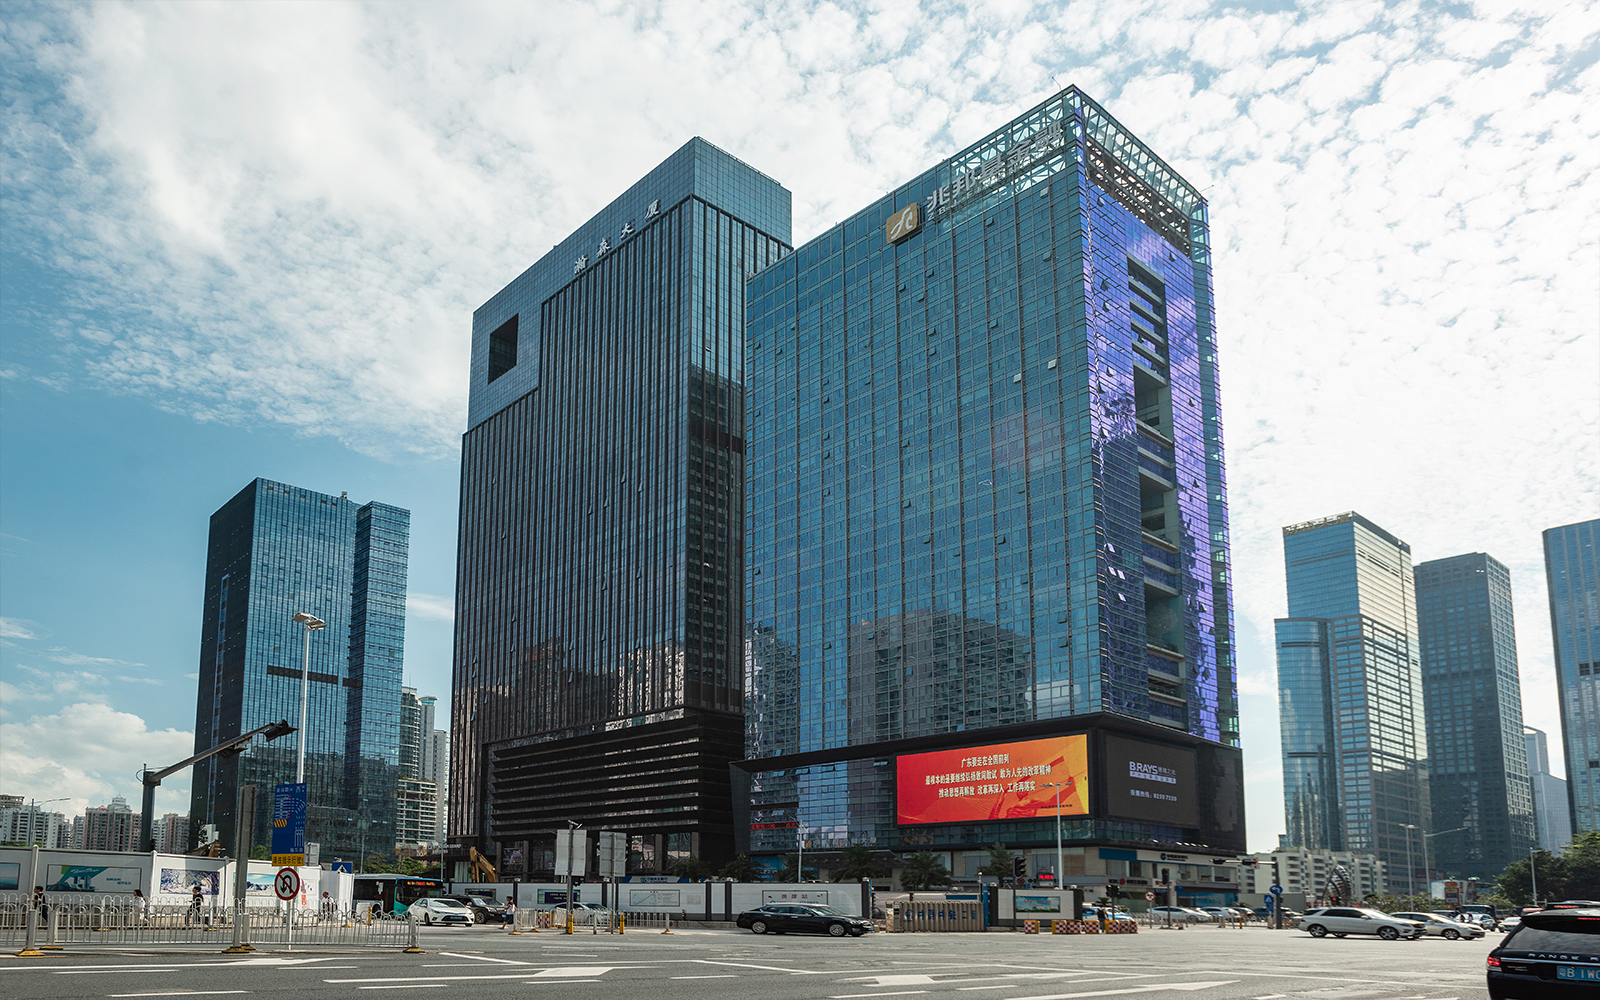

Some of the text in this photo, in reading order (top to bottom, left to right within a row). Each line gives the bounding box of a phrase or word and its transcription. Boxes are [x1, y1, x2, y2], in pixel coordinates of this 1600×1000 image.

[961, 753, 1010, 768] 广东要走在全国前列
[1129, 761, 1158, 775] BRAYS
[1000, 764, 1052, 779] 敢为人先的改革精神
[977, 784, 1005, 795] 改革再深入
[1007, 780, 1036, 793] 工作再落实
[1528, 953, 1580, 961] RANGE
